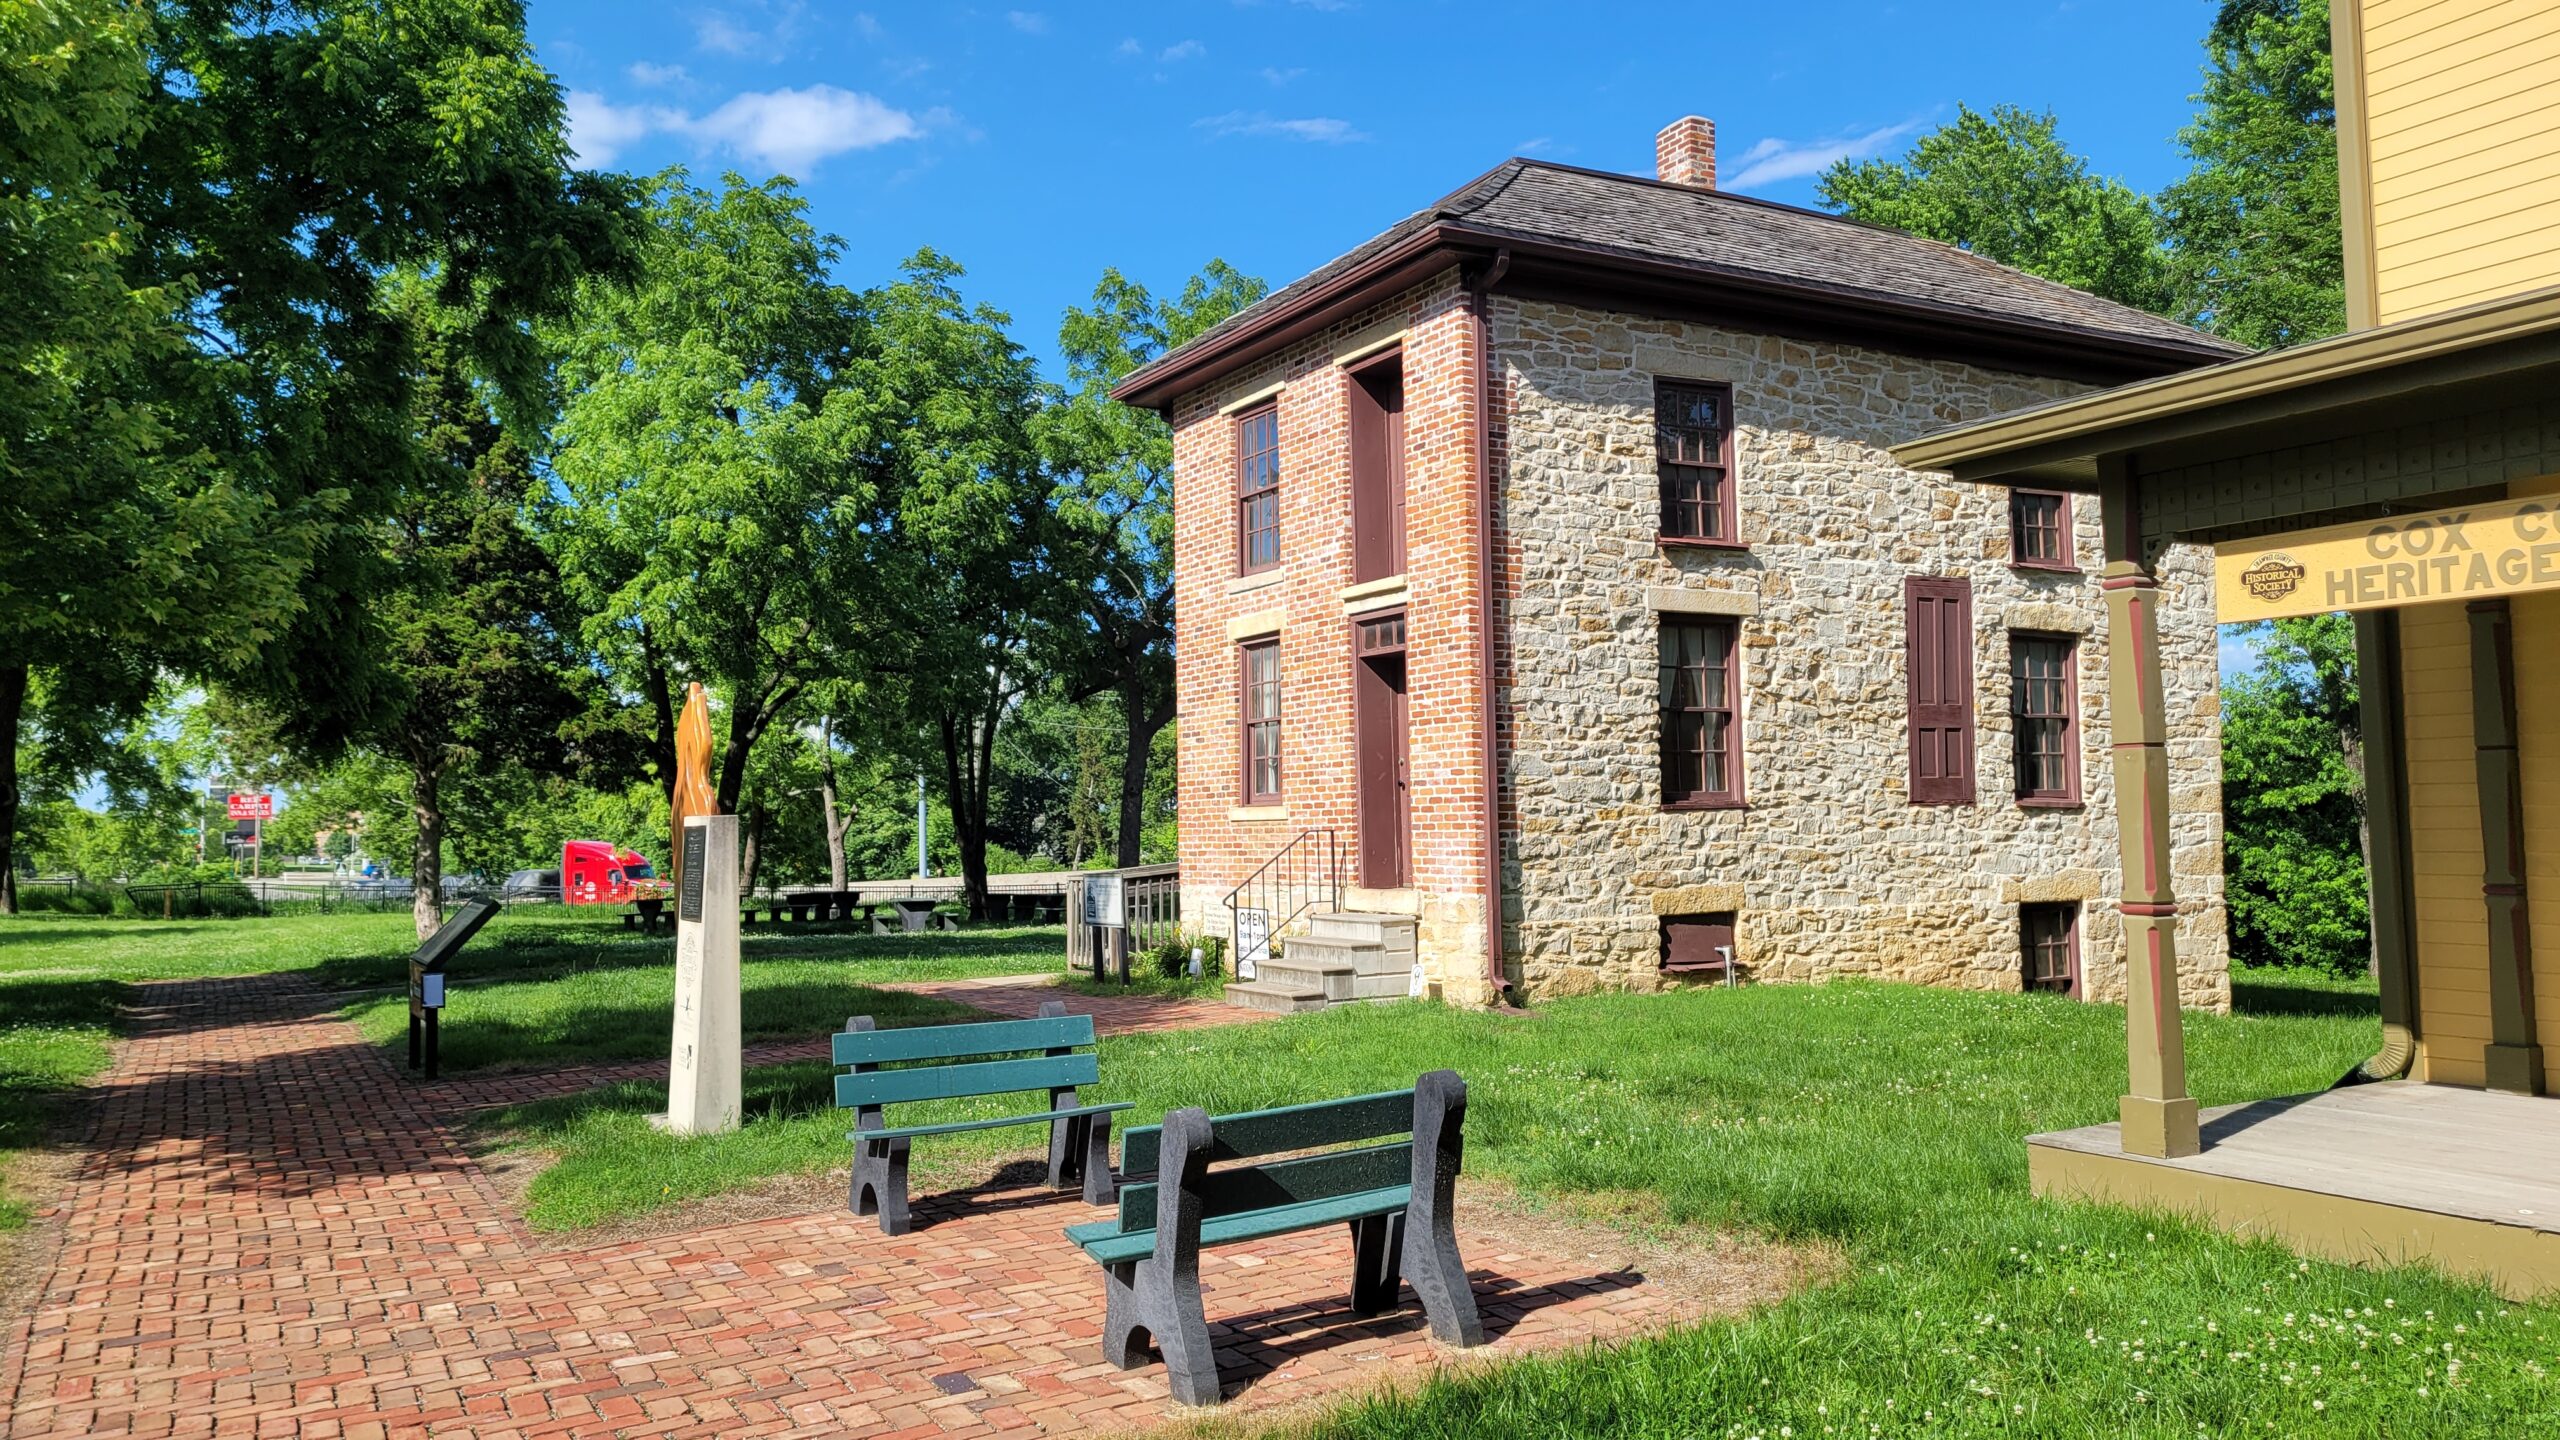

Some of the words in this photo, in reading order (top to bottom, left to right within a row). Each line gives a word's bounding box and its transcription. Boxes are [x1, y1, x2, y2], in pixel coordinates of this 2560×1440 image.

[2366, 512, 2473, 559] COX
[2513, 503, 2560, 542] C
[2254, 554, 2273, 567] SHAWNEE
[2274, 554, 2292, 565] COUNTY
[2245, 568, 2301, 585] HISTORICAL
[2326, 543, 2560, 606] HERITAGE
[2253, 579, 2293, 593] SOCIETY
[1239, 912, 1266, 927] OPEN
